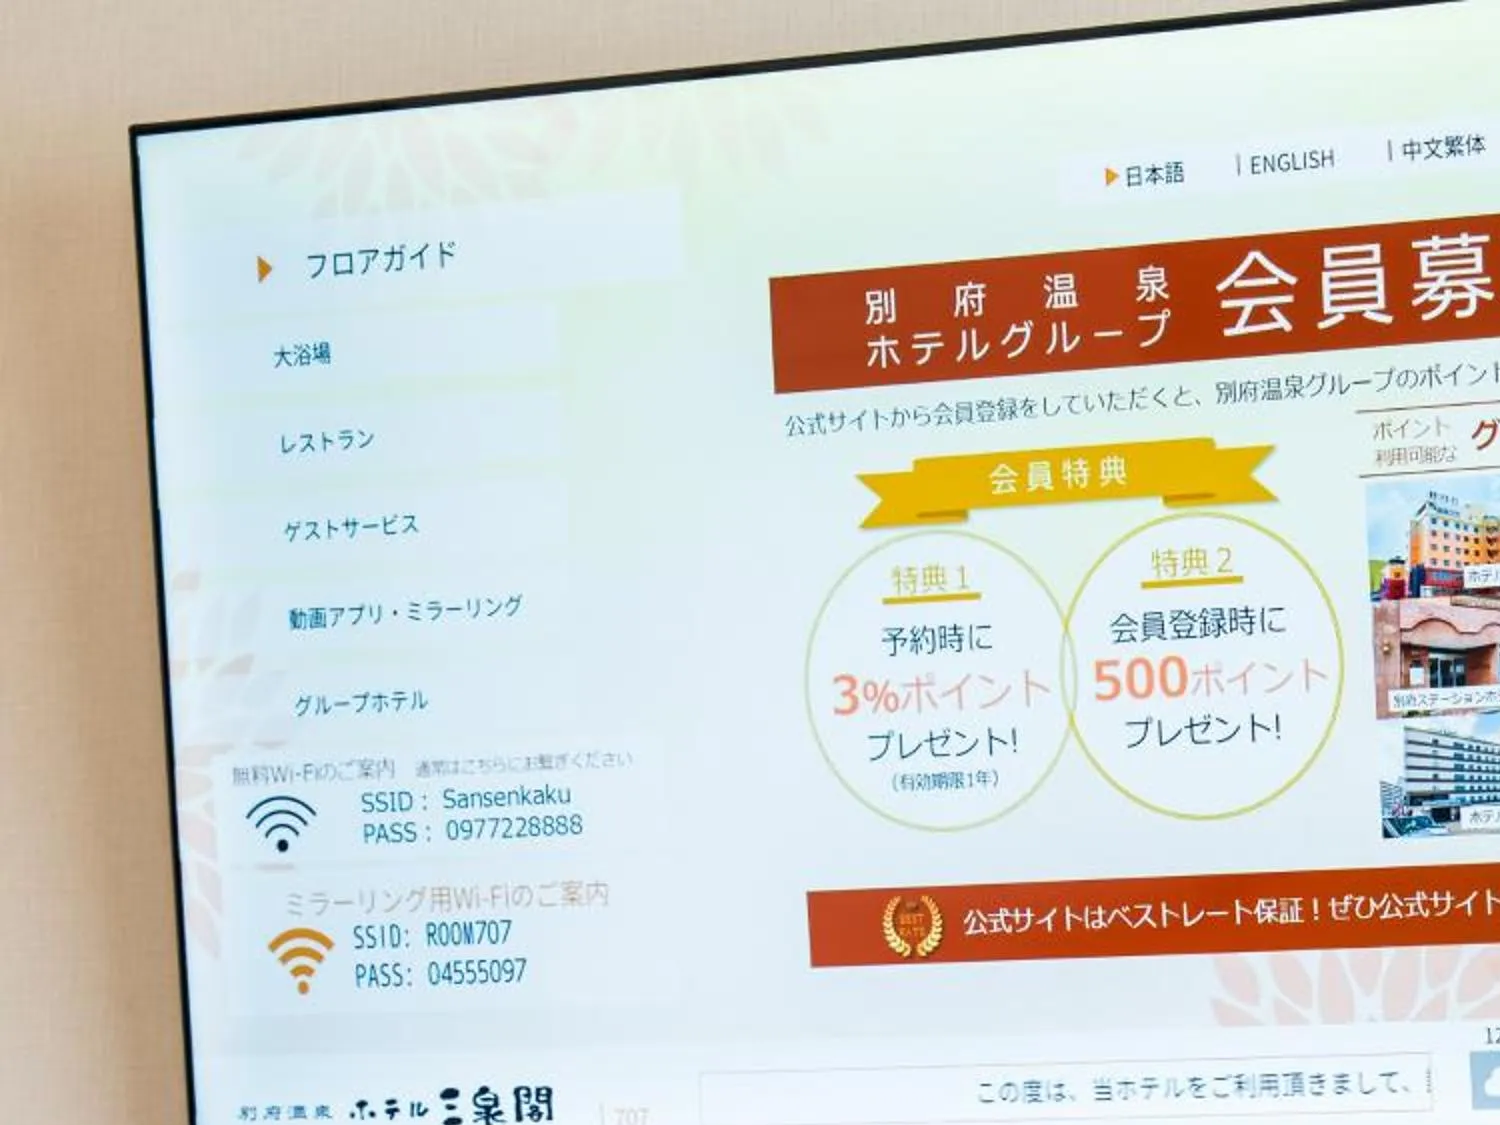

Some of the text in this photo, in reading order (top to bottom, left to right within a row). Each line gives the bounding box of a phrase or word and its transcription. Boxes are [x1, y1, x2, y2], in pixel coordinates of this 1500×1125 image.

[1249, 148, 1335, 176] ENGLISH
[1402, 133, 1486, 161] 中文繁体
[1125, 160, 1185, 188] 日本語
[306, 240, 457, 280] フロアガイド
[865, 264, 1171, 325] 別府温泉
[273, 340, 331, 369] 大浴場
[866, 308, 1171, 369] ホテルグループ
[280, 428, 375, 455] レストラン
[1373, 413, 1450, 441] ポイント
[987, 455, 1129, 496] 会員特典
[283, 513, 420, 543] ゲストサービス
[288, 595, 524, 632] 動画アプリ・ミラーリング
[1109, 605, 1288, 645] 会員登録時に
[880, 622, 994, 658] 予約時に
[831, 668, 1053, 718] 3%ポイント
[1093, 654, 1329, 703] 500ポイント
[295, 690, 429, 718] グループホテル
[867, 726, 1021, 763] プレゼント!
[1124, 712, 1284, 750] プレゼント!
[442, 784, 572, 811] Sansenkaku
[446, 814, 584, 843] 0977228888
[427, 958, 528, 987] 04555097
[977, 1068, 1434, 1105] この度は、当ホテルをご利用頂きまして、
